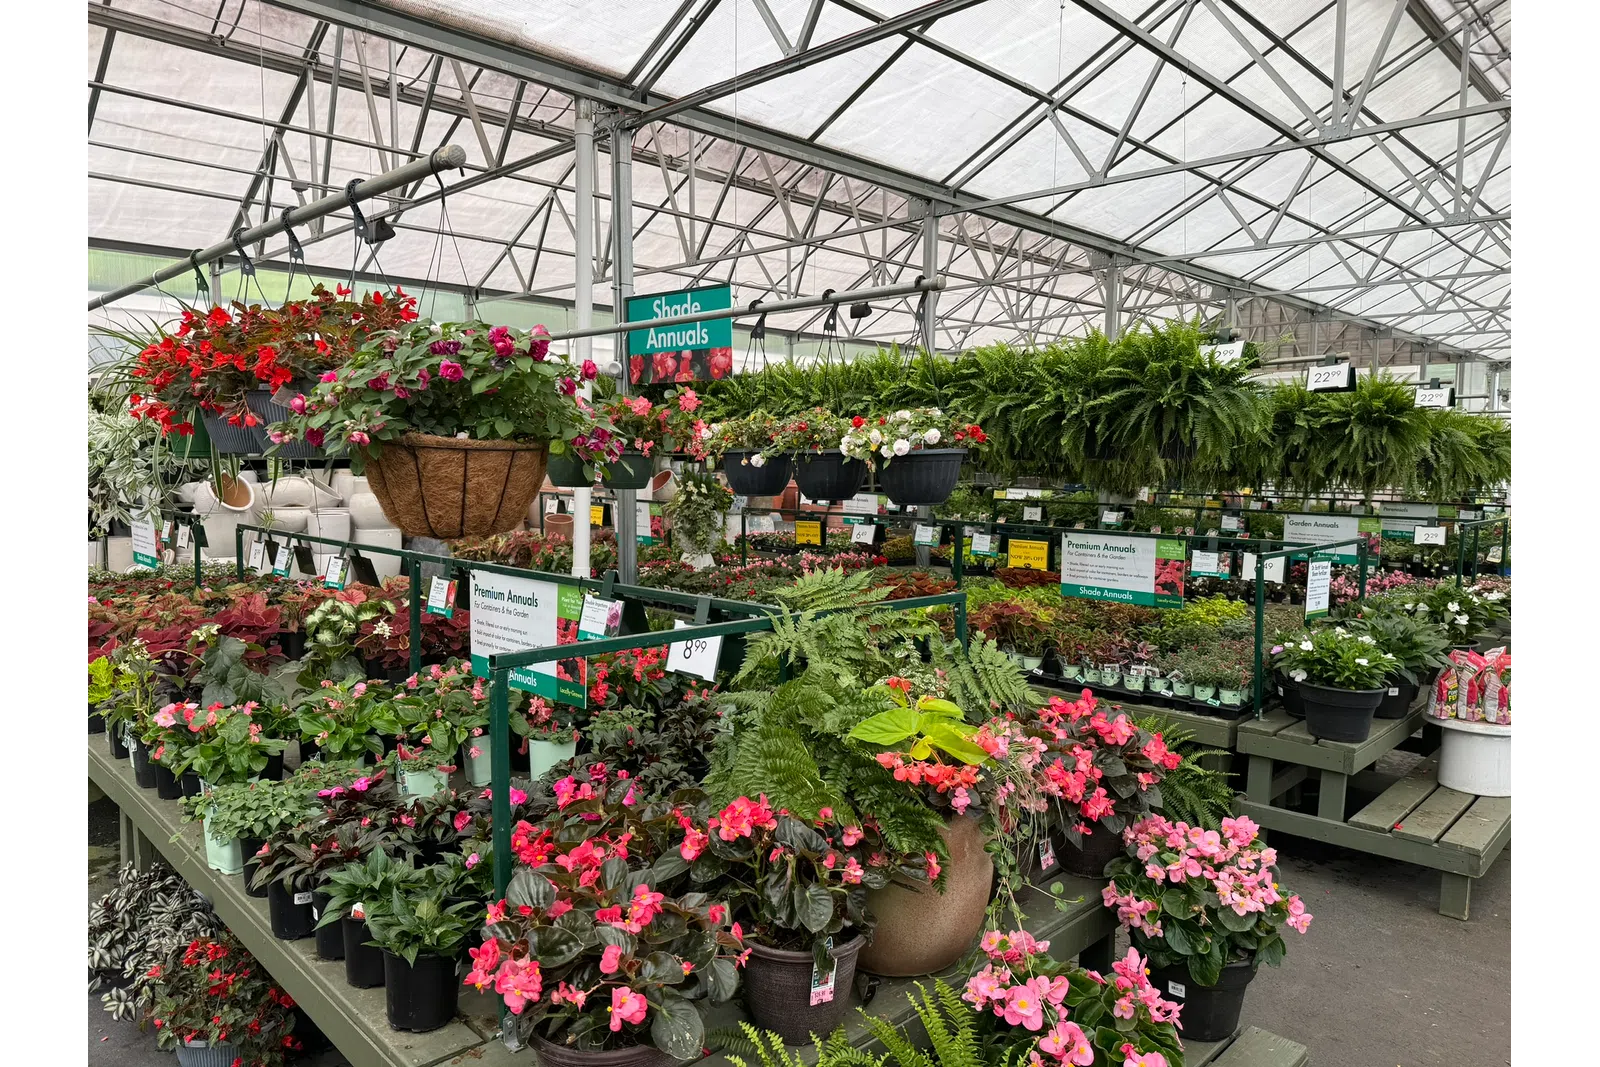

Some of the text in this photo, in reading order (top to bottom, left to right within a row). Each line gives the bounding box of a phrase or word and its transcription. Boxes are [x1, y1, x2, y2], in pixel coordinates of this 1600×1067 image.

[653, 293, 701, 320] Shade
[646, 321, 709, 349] Annuals
[1289, 519, 1339, 529] Garden Annuals
[1067, 540, 1136, 554] Premium Annuals
[474, 583, 538, 608] Premium Annuals
[1080, 586, 1132, 600] Shade Annuals
[480, 602, 501, 614] Containers
[513, 608, 530, 618] Garden
[508, 670, 537, 687] Annuals
[560, 686, 583, 699] Locally-Grown
